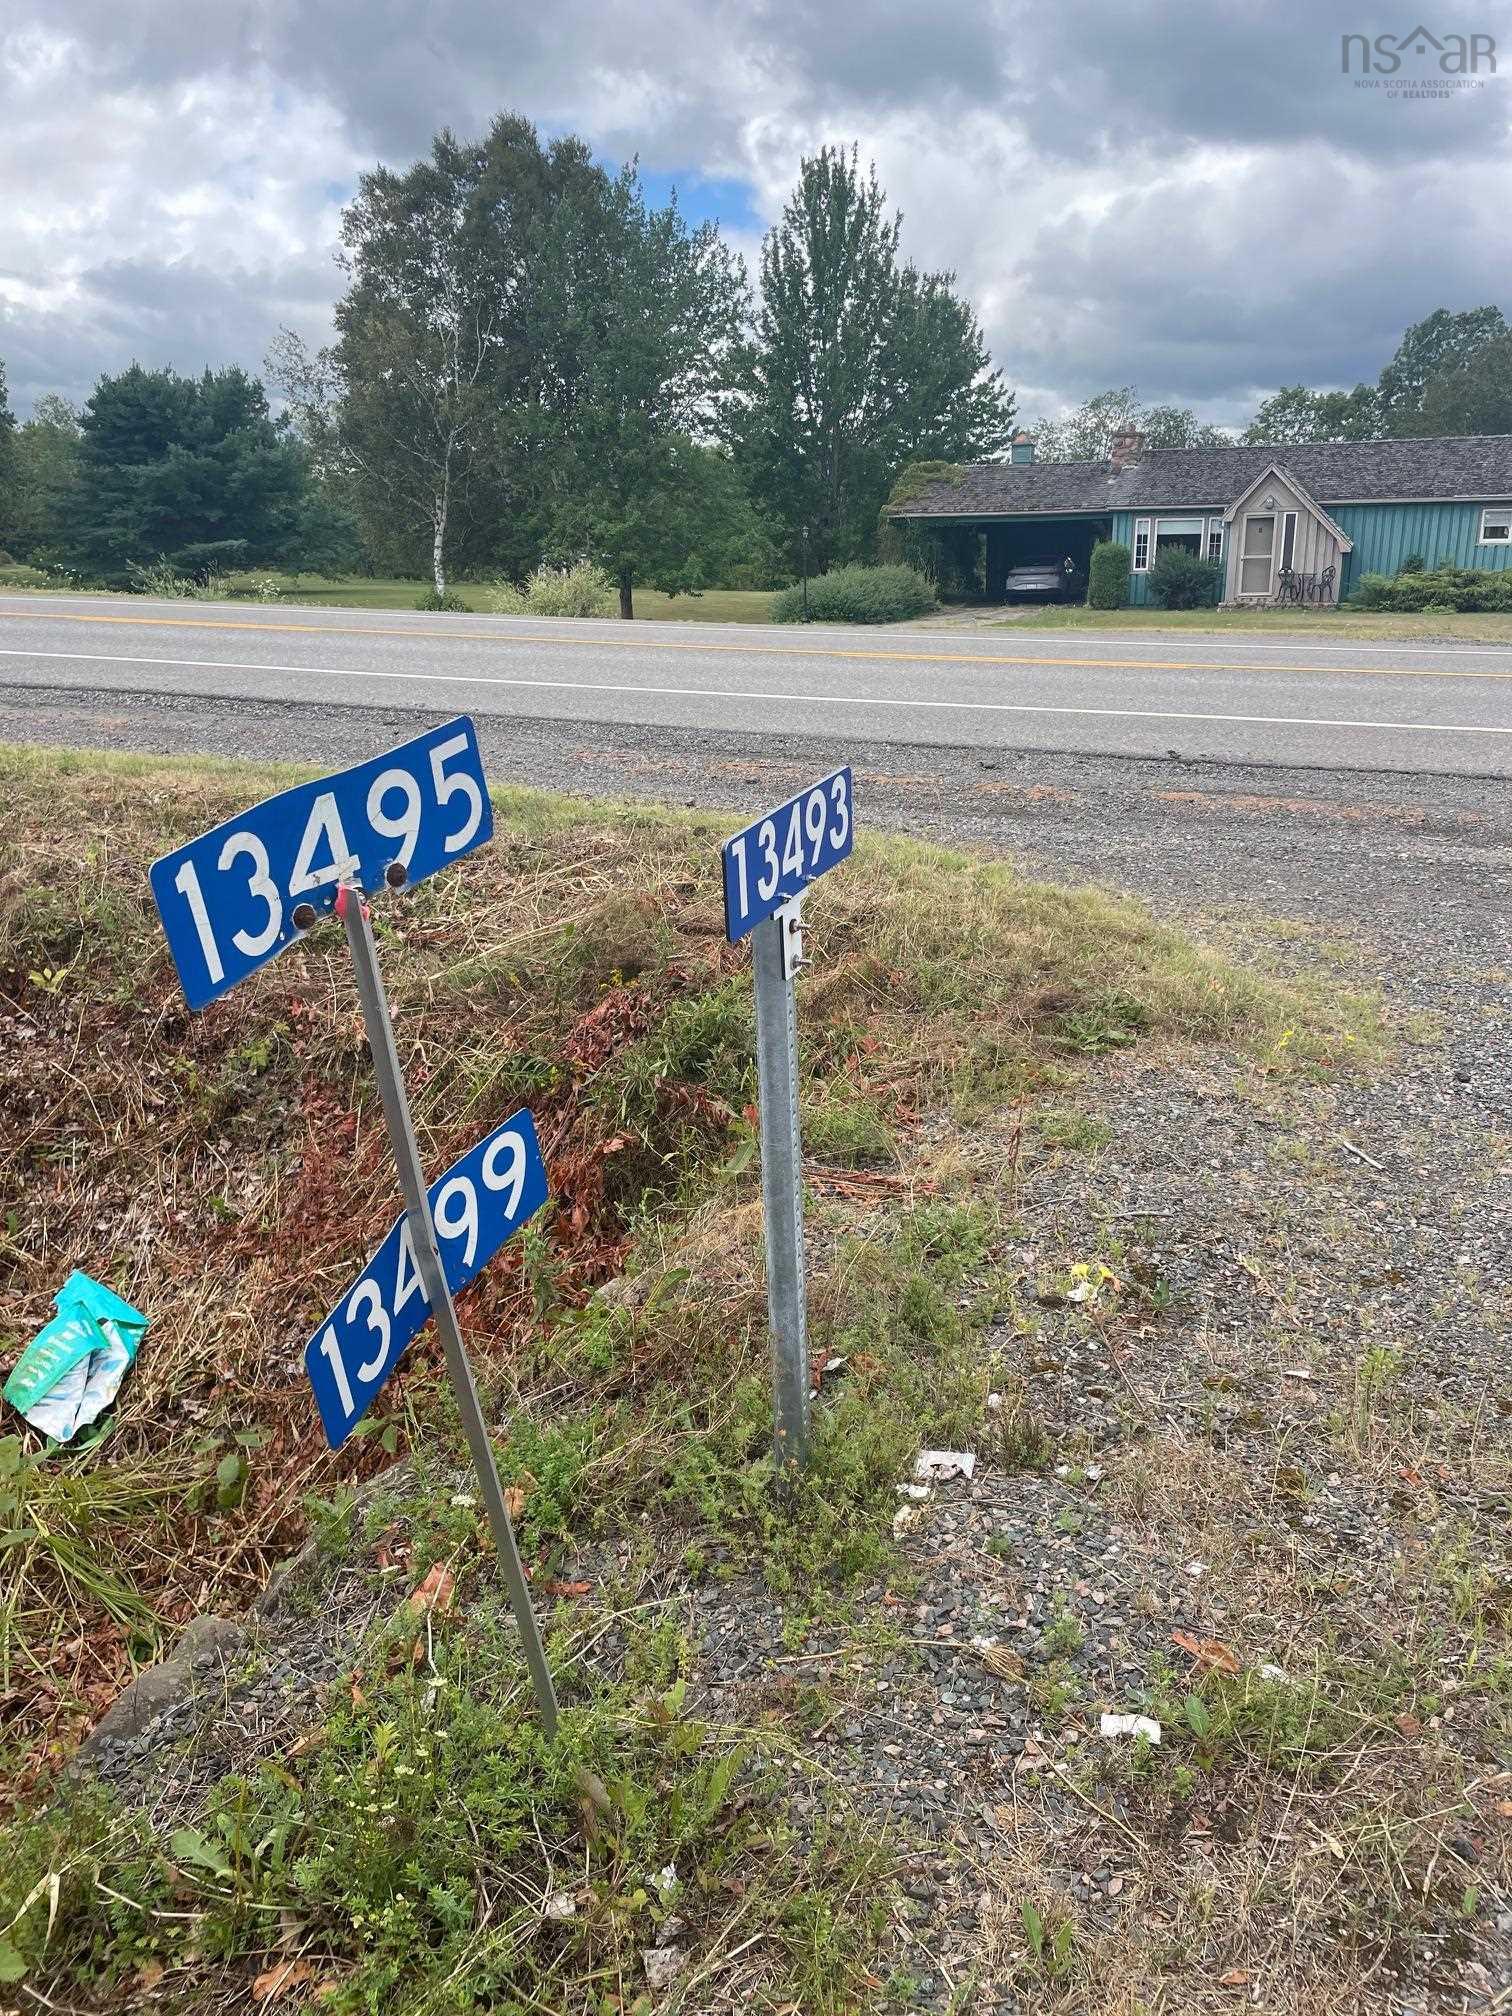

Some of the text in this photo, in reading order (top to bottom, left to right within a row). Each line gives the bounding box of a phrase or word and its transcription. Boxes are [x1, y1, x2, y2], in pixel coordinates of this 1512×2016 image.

[174, 732, 483, 985] 13495
[731, 774, 849, 919] 13493
[320, 1130, 527, 1419] 13499
